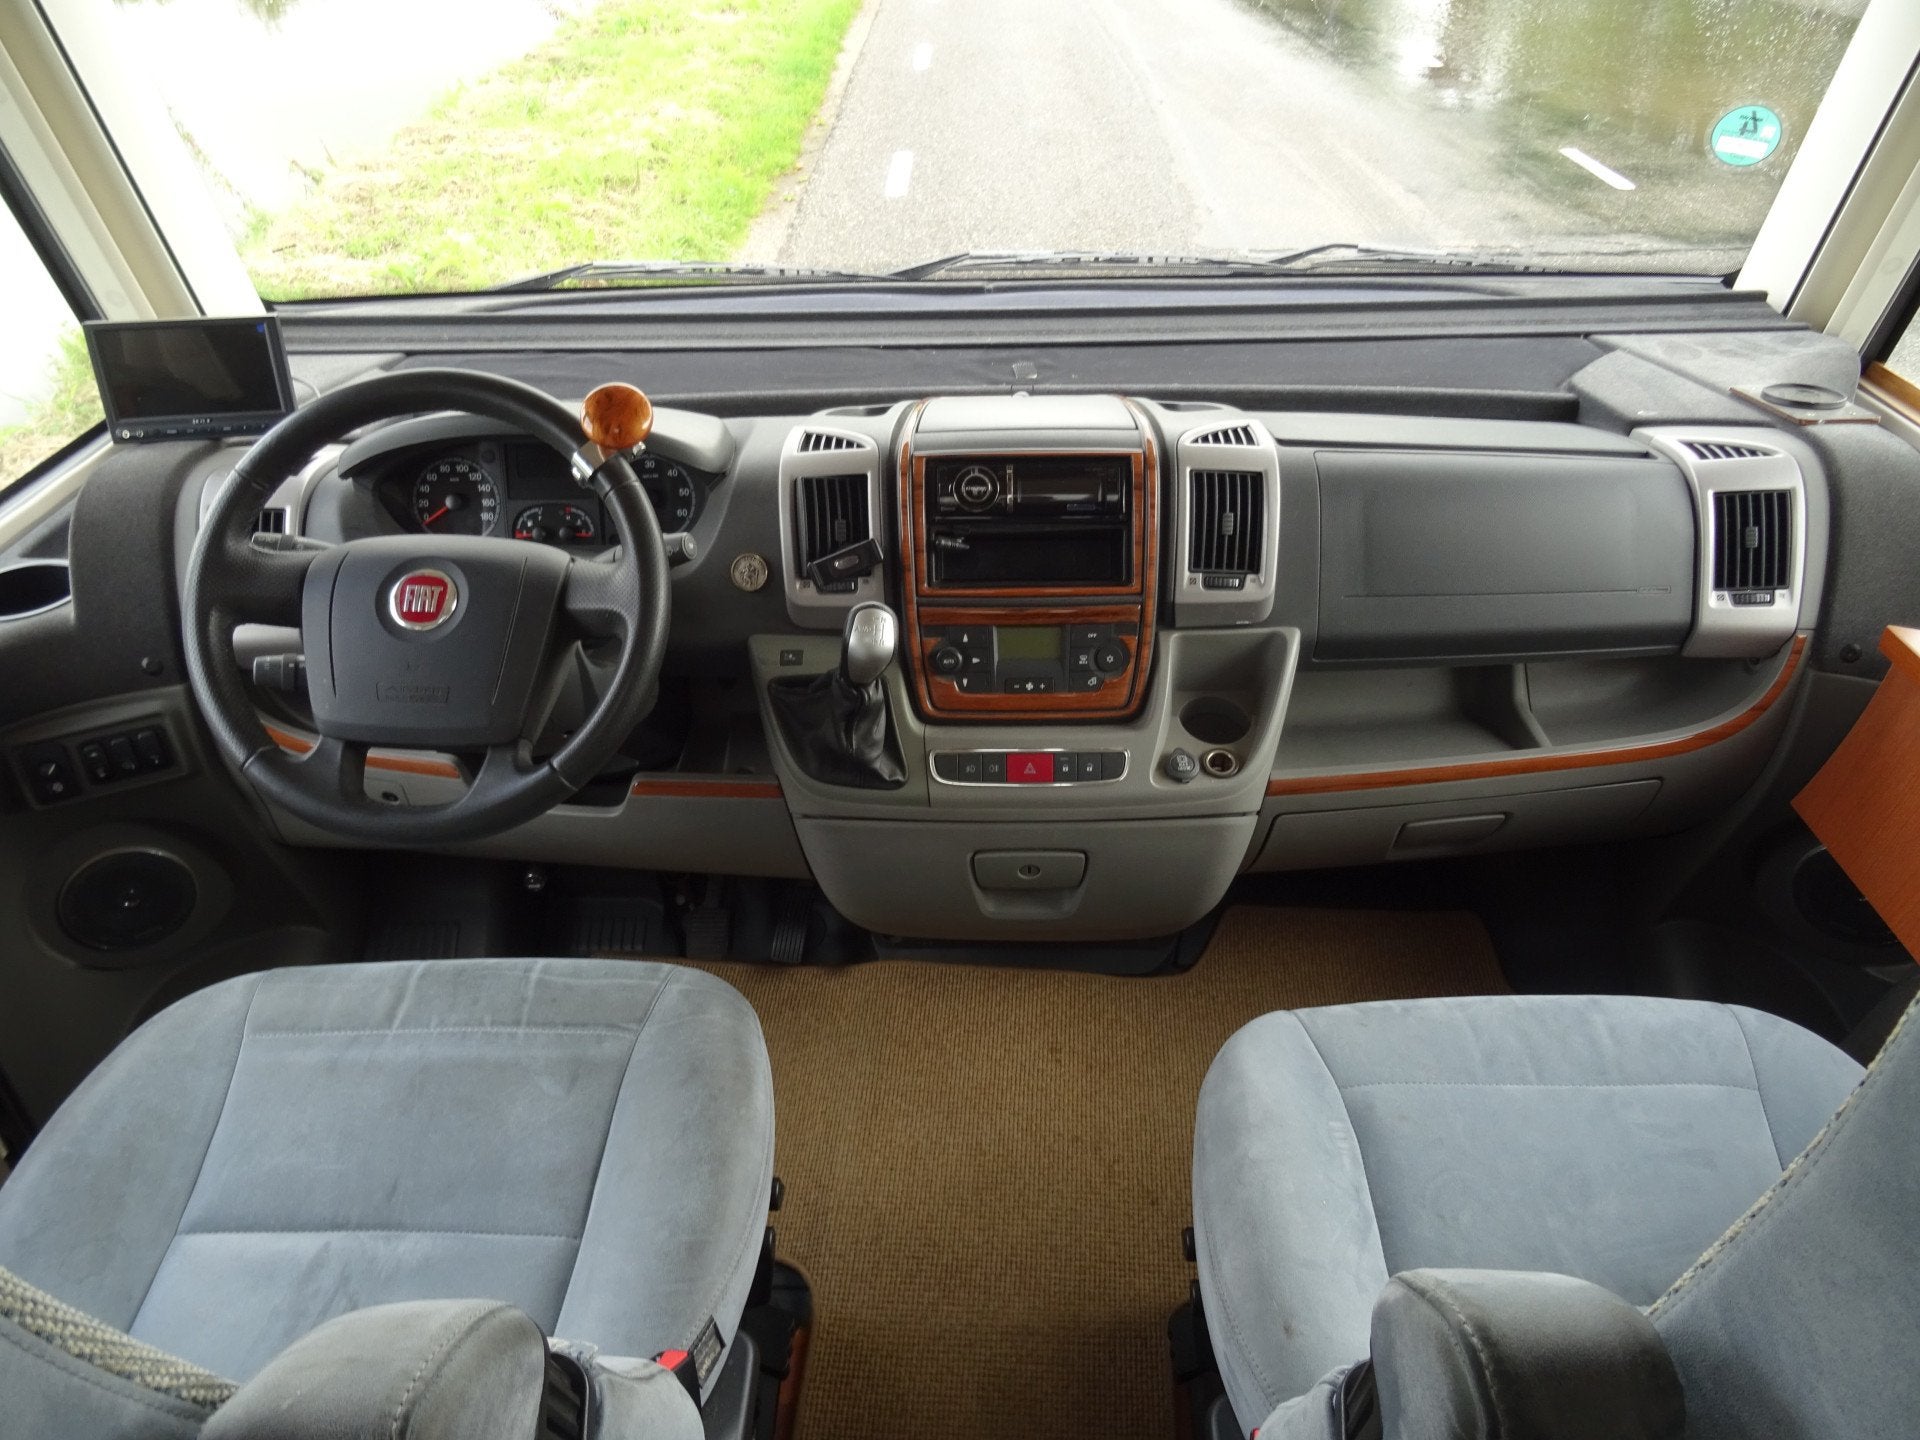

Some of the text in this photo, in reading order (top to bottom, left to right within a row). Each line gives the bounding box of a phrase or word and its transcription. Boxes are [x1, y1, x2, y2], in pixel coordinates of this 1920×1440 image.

[440, 464, 451, 473] 80
[455, 464, 469, 473] 100
[426, 473, 438, 481] 60
[468, 473, 482, 481] 120
[420, 484, 430, 493] 40
[478, 484, 491, 493] 140
[679, 487, 690, 497] 50
[419, 498, 429, 507] 20
[481, 498, 495, 507] 160
[480, 511, 494, 521] 180
[677, 508, 688, 517] 60
[403, 584, 443, 613] FIAT
